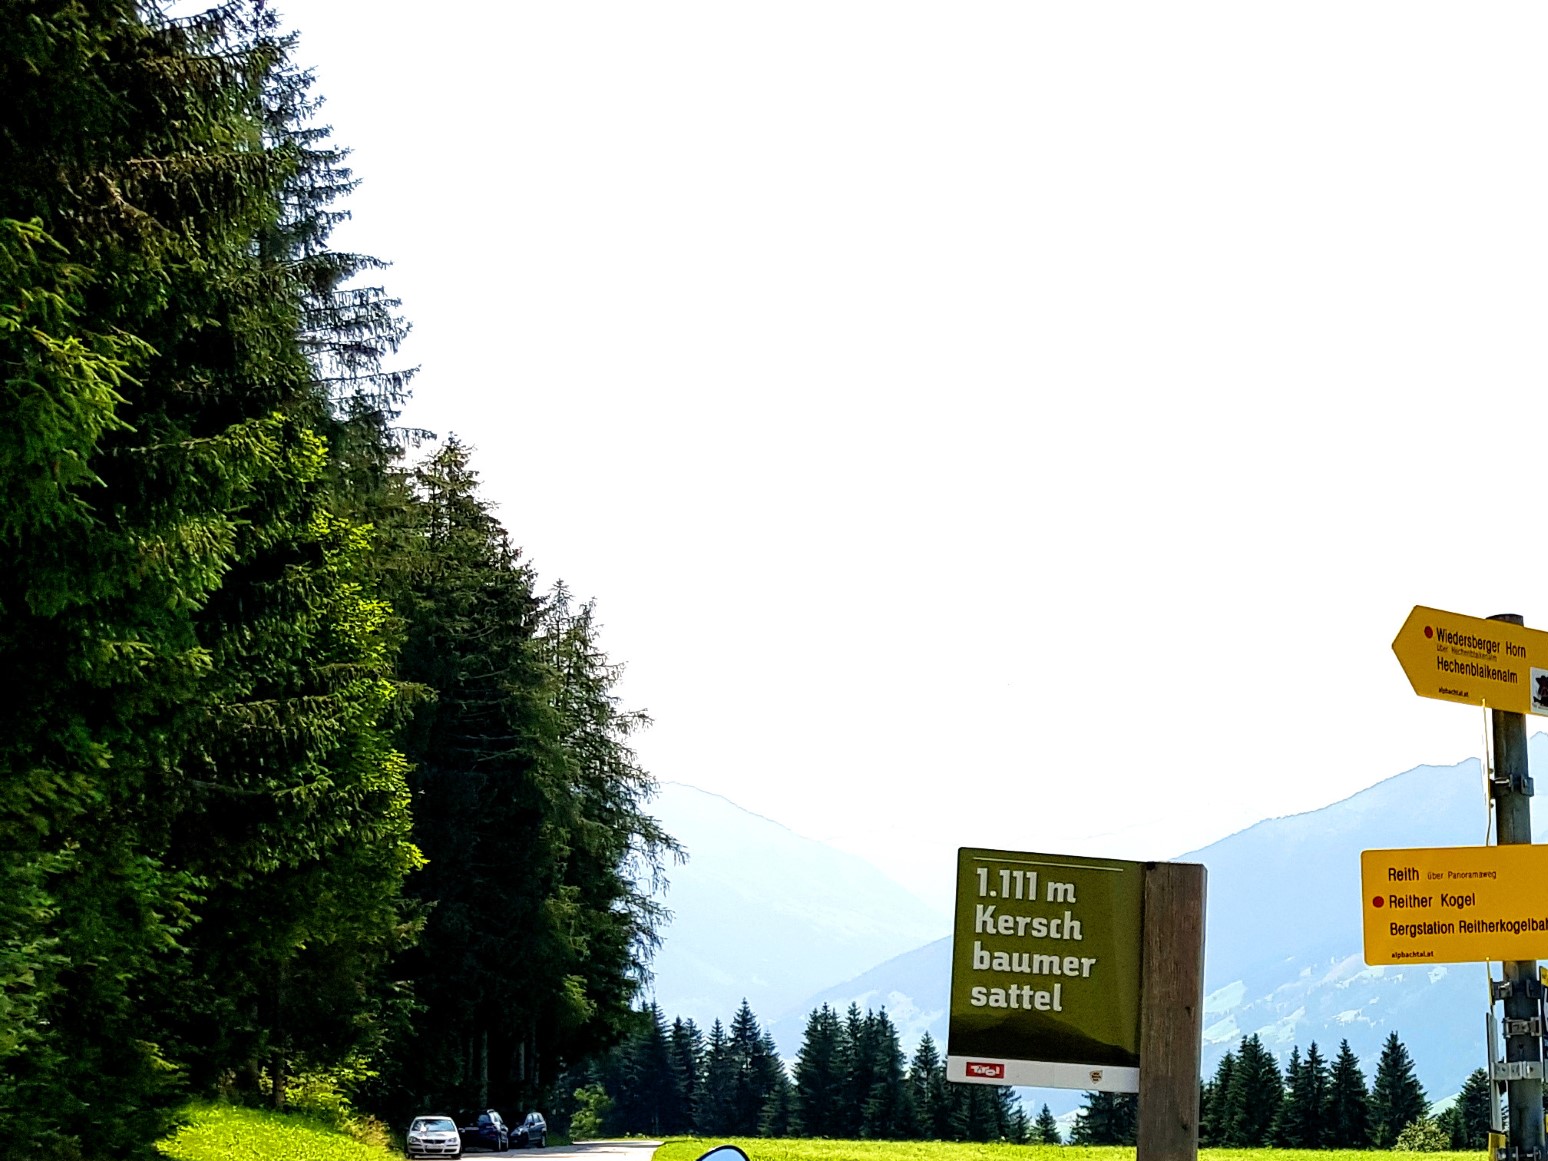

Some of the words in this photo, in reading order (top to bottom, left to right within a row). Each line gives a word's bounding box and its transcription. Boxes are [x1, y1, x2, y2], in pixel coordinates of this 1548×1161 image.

[1436, 627, 1501, 654] Wiedersberger
[1505, 641, 1527, 659] Horn
[1436, 656, 1518, 684] Hechenblaikenalm
[976, 866, 1039, 901] 1.111
[1046, 880, 1077, 904] m
[1388, 867, 1420, 881] Reith
[1427, 872, 1444, 880] über
[1447, 871, 1497, 880] Panoramaweg
[1389, 894, 1433, 908] Reither
[1440, 892, 1476, 910] Kogel
[974, 904, 1083, 941] Kersch
[1389, 920, 1455, 938] Bergstation
[972, 940, 1097, 978] baumer
[1391, 950, 1434, 959] alpbachtal.at
[970, 983, 1063, 1012] sattel
